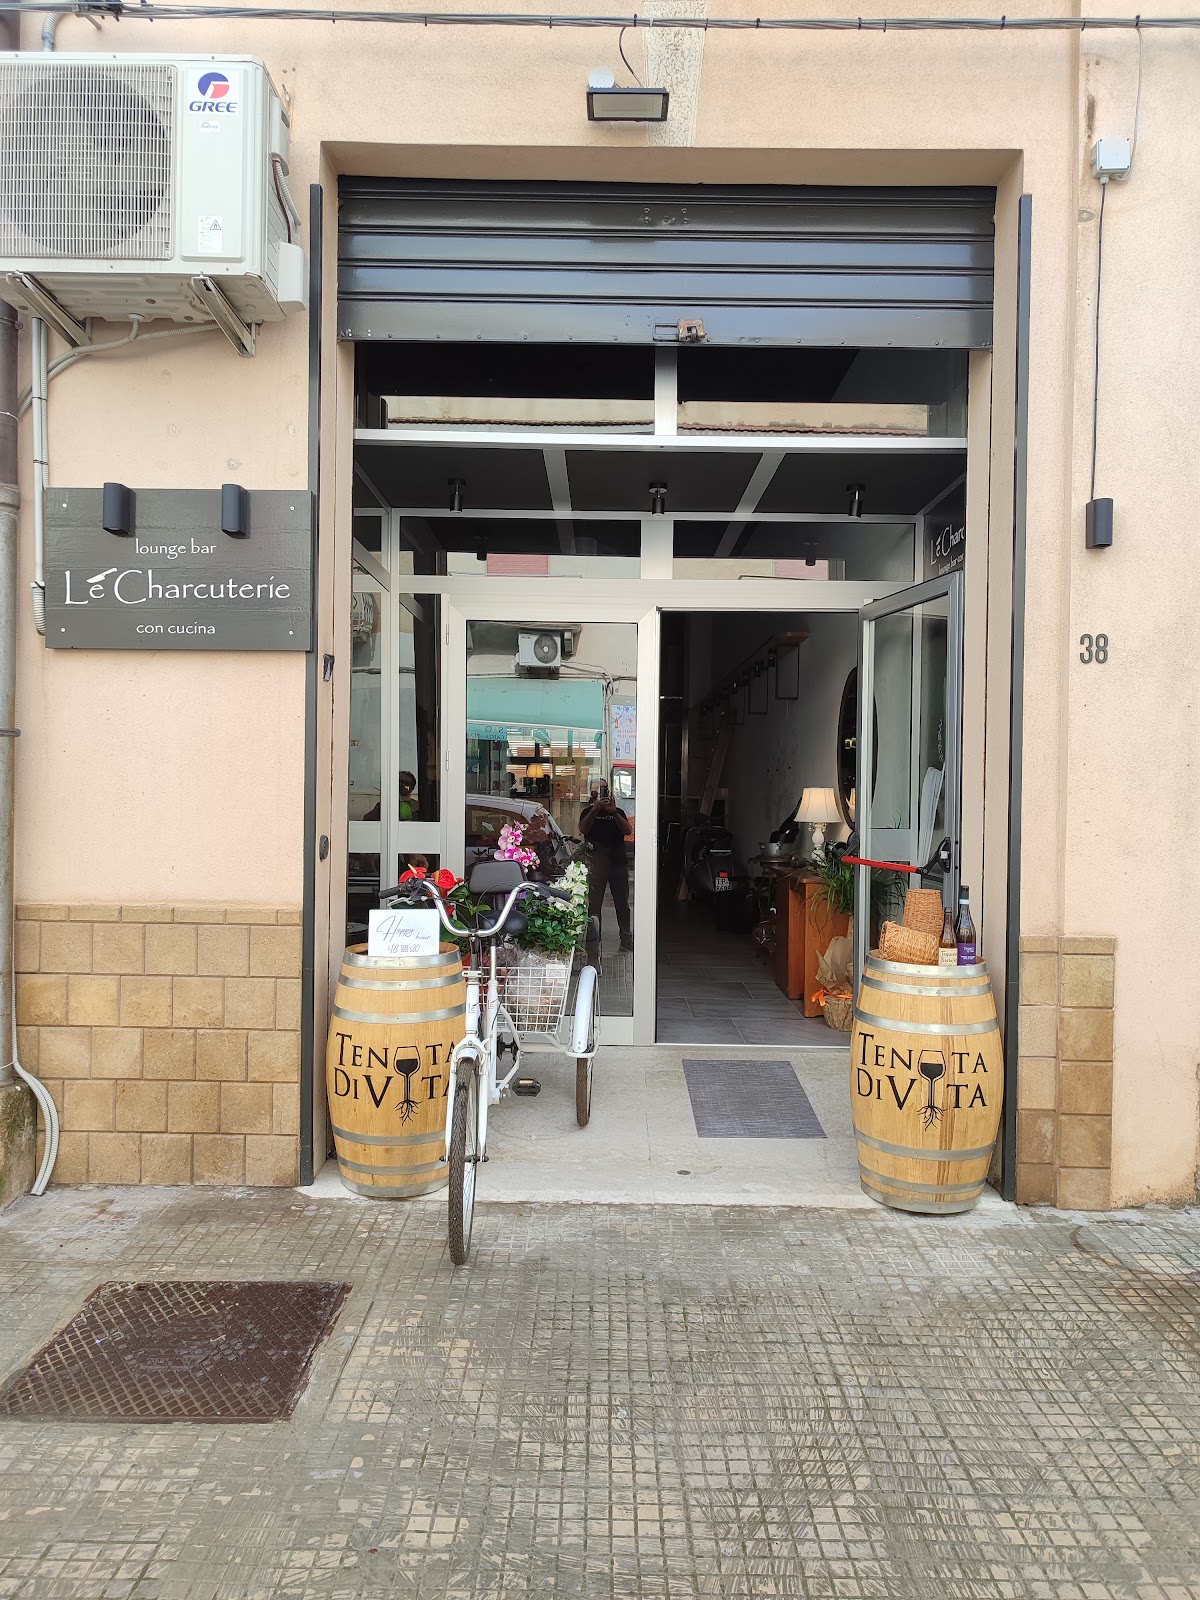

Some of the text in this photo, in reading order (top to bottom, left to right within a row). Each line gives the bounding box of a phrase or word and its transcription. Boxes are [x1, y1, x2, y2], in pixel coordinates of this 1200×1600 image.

[189, 100, 238, 113] GREE
[135, 538, 217, 560] lounge bar
[113, 568, 291, 605] Charcuterie
[136, 621, 217, 635] con cucina
[1079, 633, 1109, 664] 38
